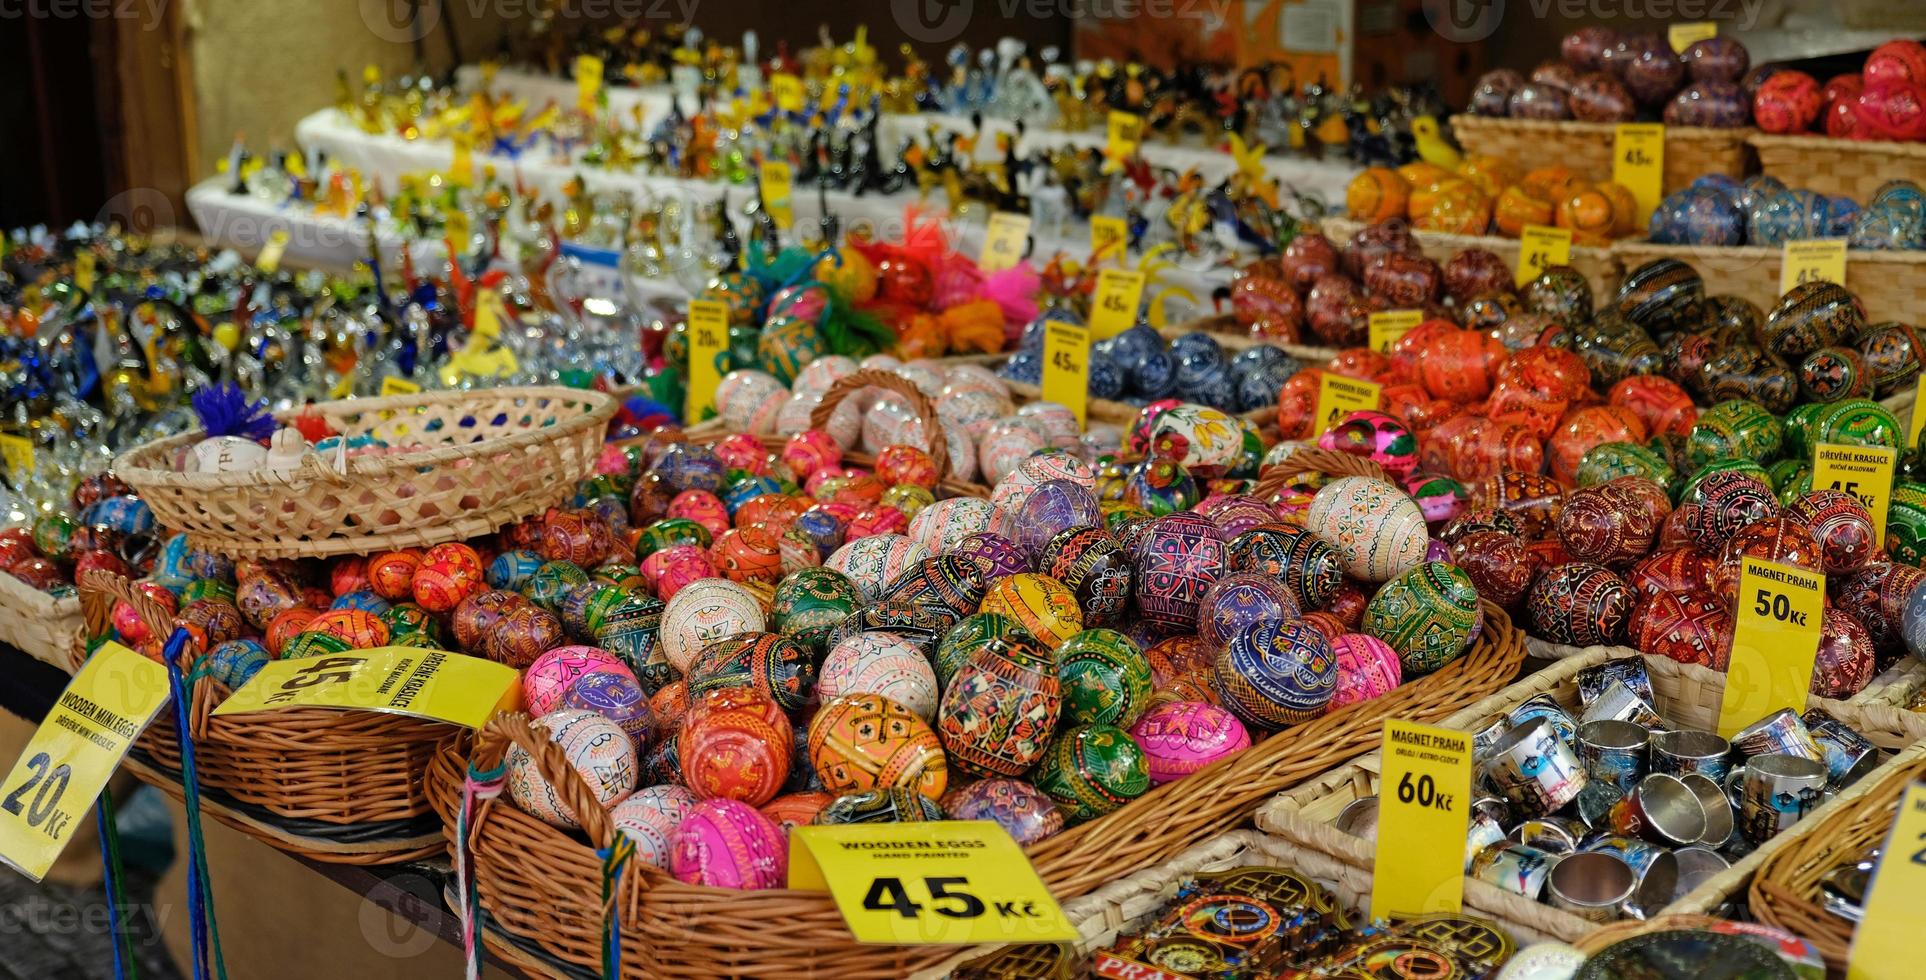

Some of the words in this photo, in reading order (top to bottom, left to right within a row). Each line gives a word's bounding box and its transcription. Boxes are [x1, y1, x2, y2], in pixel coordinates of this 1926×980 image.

[1053, 350, 1071, 371] 45
[1820, 450, 1852, 461] DŘEVĚNÉ
[1854, 454, 1888, 465] KRASLICE
[1748, 565, 1786, 582] MAGNET
[1787, 574, 1818, 591] PRAHA
[1754, 589, 1790, 621] 50
[1790, 610, 1807, 627] Kč
[281, 657, 369, 690] 45
[420, 653, 446, 677] DŘEVĚNÉ
[394, 677, 428, 708] KRASLICE
[60, 691, 102, 718] WOODEN
[97, 708, 116, 727] MINI
[113, 718, 139, 738] EGGS
[78, 725, 92, 739] MINI
[1391, 729, 1432, 748] MAGNET
[1433, 736, 1466, 753] PRAHA
[1395, 747, 1415, 758] ORLOJ
[1, 752, 72, 828] 20
[43, 809, 72, 840] Kč
[1397, 771, 1435, 807] 60
[1435, 793, 1454, 812] Kč
[839, 840, 931, 850] WOODEN
[936, 840, 987, 849] EGGS
[862, 876, 986, 919] 45
[993, 898, 1042, 919] Kč
[1098, 958, 1182, 980] PRA
